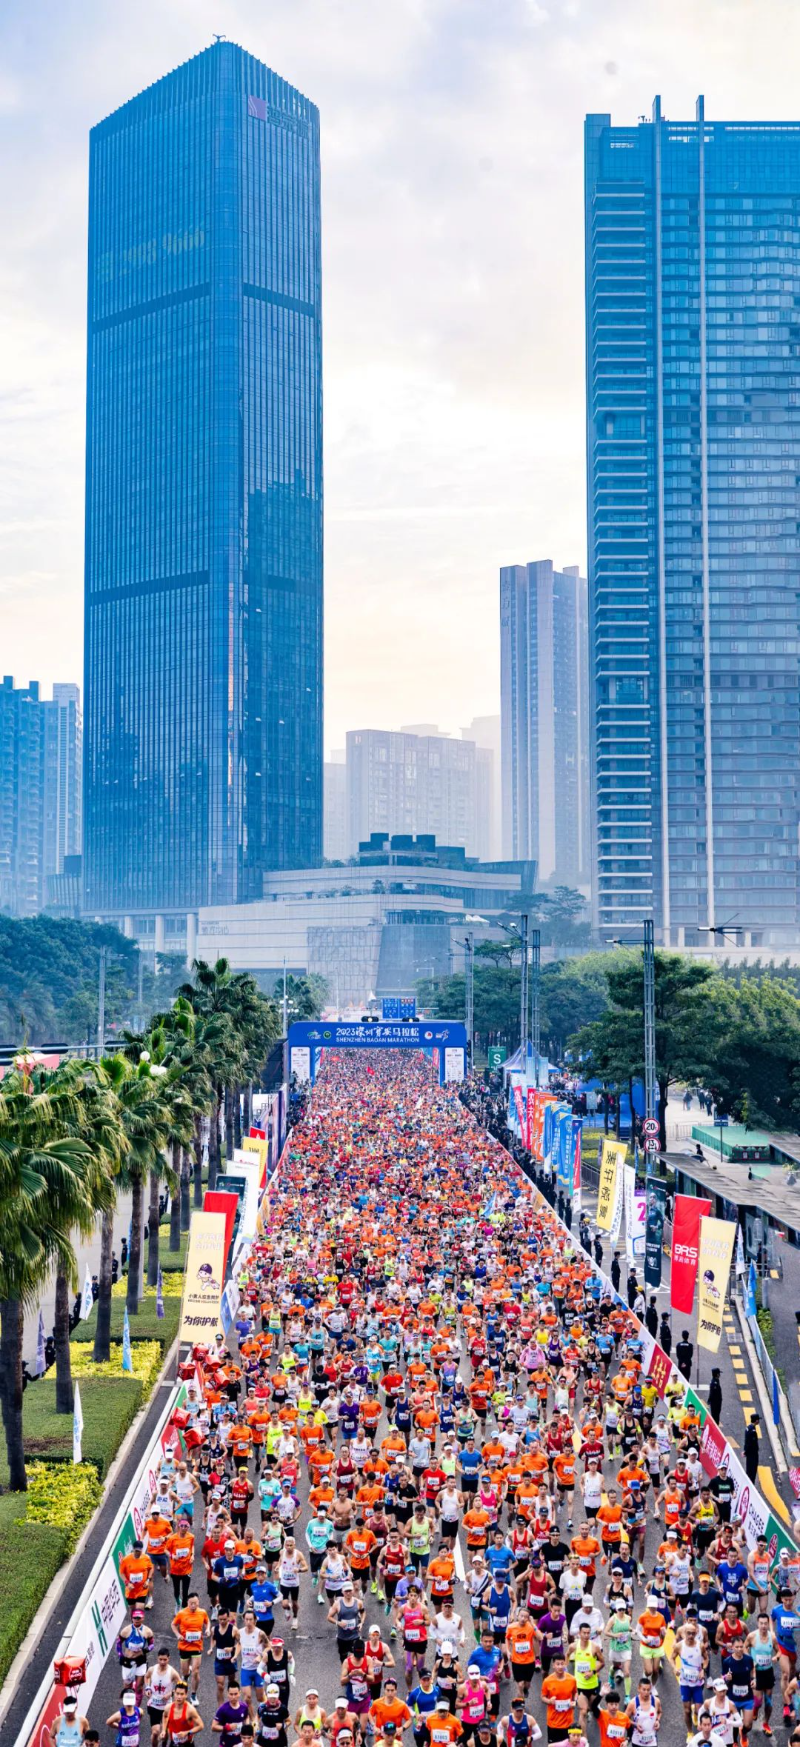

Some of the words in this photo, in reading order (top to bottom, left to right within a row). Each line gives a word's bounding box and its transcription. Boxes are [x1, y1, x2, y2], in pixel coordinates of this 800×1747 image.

[493, 1053, 502, 1065] S
[674, 1243, 698, 1259] BRS
[183, 1315, 219, 1327] 为你护航
